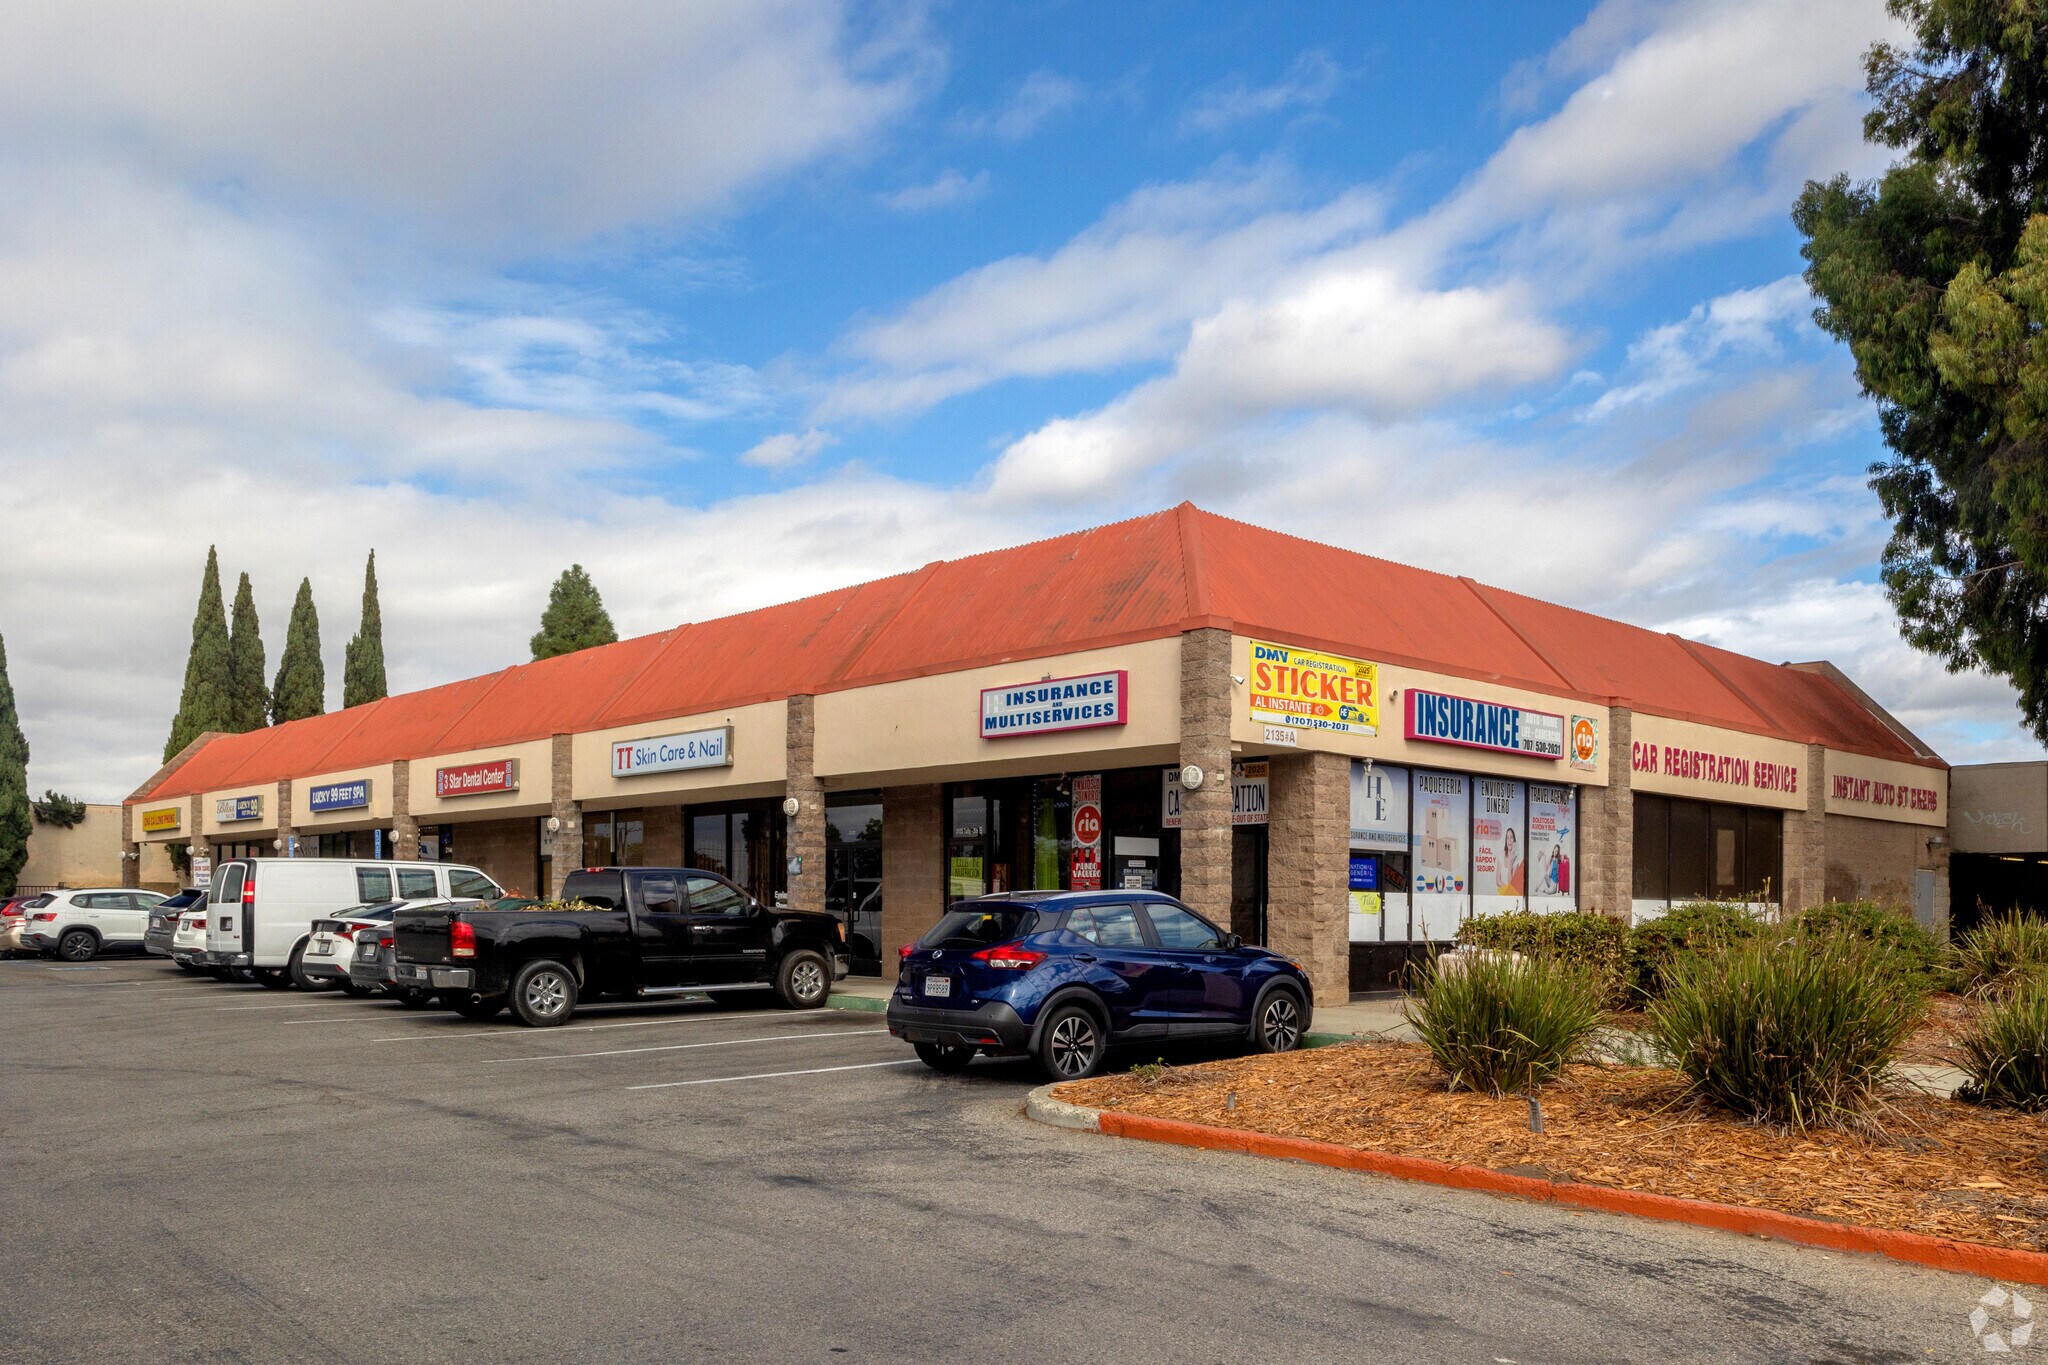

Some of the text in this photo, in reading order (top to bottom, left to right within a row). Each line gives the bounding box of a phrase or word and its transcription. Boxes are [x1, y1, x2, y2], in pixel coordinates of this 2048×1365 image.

[1255, 646, 1288, 663] DMV
[1294, 657, 1347, 673] CAR REGISTRATION
[1006, 680, 1113, 706] INSURANCE
[1255, 662, 1374, 707] STICKER
[1255, 696, 1267, 708] AL
[1269, 697, 1312, 714] INSTANTE
[984, 702, 1114, 730] MULTISERVICES
[1417, 692, 1520, 749] INSURANCE
[1265, 729, 1295, 743] 2135#A
[1577, 727, 1593, 748] ria
[617, 737, 723, 770] TT Skin Care & Nail
[1632, 741, 1798, 793] CAR REGISTRATION SERVICE
[444, 774, 449, 790] 3
[449, 773, 462, 789] Star
[463, 769, 482, 788] Dental
[483, 768, 505, 785] Center
[1168, 772, 1180, 782] DM
[1419, 775, 1462, 795] PAQUETERIA
[312, 785, 364, 804] LUCKY 99 FEET SPA
[1481, 780, 1515, 799] ENVIOS DE
[1530, 786, 1549, 803] TRAVEL
[1831, 775, 1871, 803] INSTANT
[1873, 781, 1895, 806] AUTO
[1168, 790, 1181, 816] CA
[1486, 797, 1510, 814] DINERO
[1078, 812, 1099, 832] ria
[1476, 819, 1489, 835] ria
[1073, 869, 1101, 878] VAQUERO
[1076, 862, 1097, 870] MUNDO
